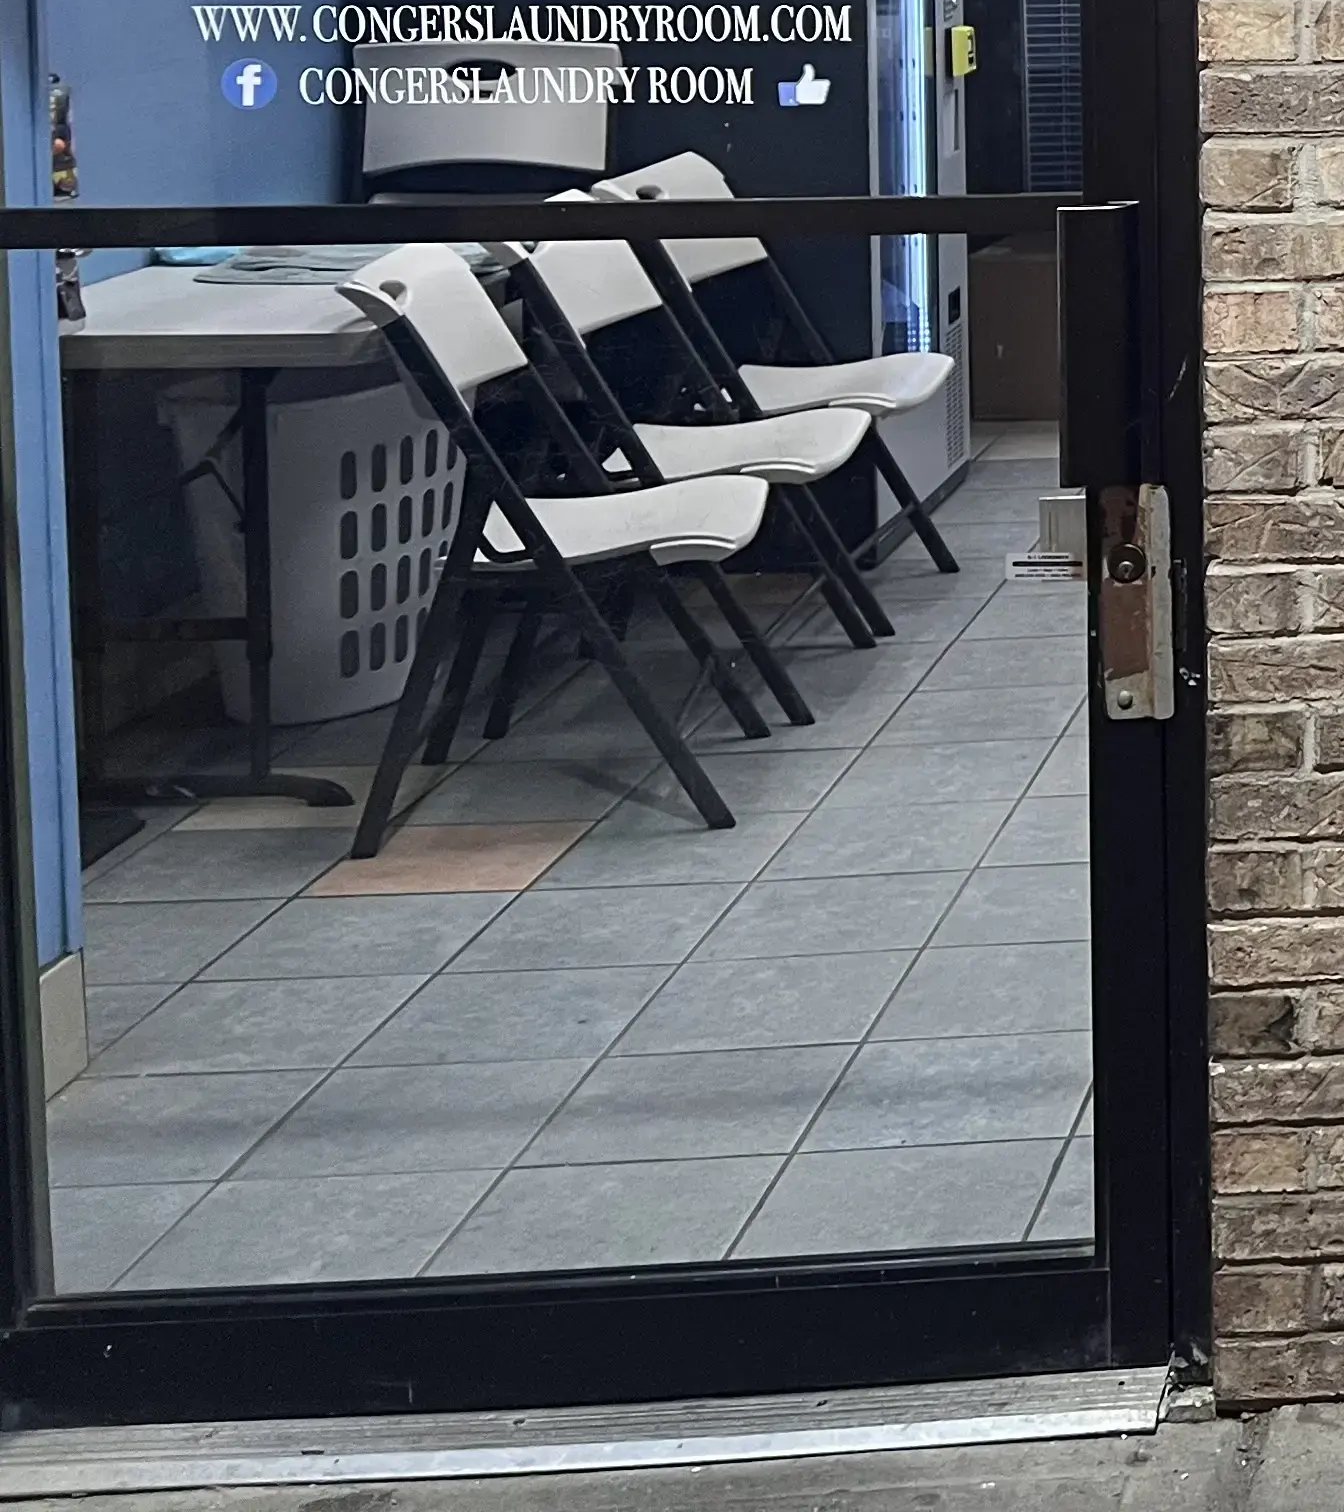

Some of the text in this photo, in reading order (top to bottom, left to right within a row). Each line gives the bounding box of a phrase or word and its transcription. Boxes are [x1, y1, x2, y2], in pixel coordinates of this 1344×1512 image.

[190, 4, 853, 44] WWW.CONGERSLAUNDRYROOM.COM
[298, 66, 755, 106] CONGERSLAUNDRY ROOM
